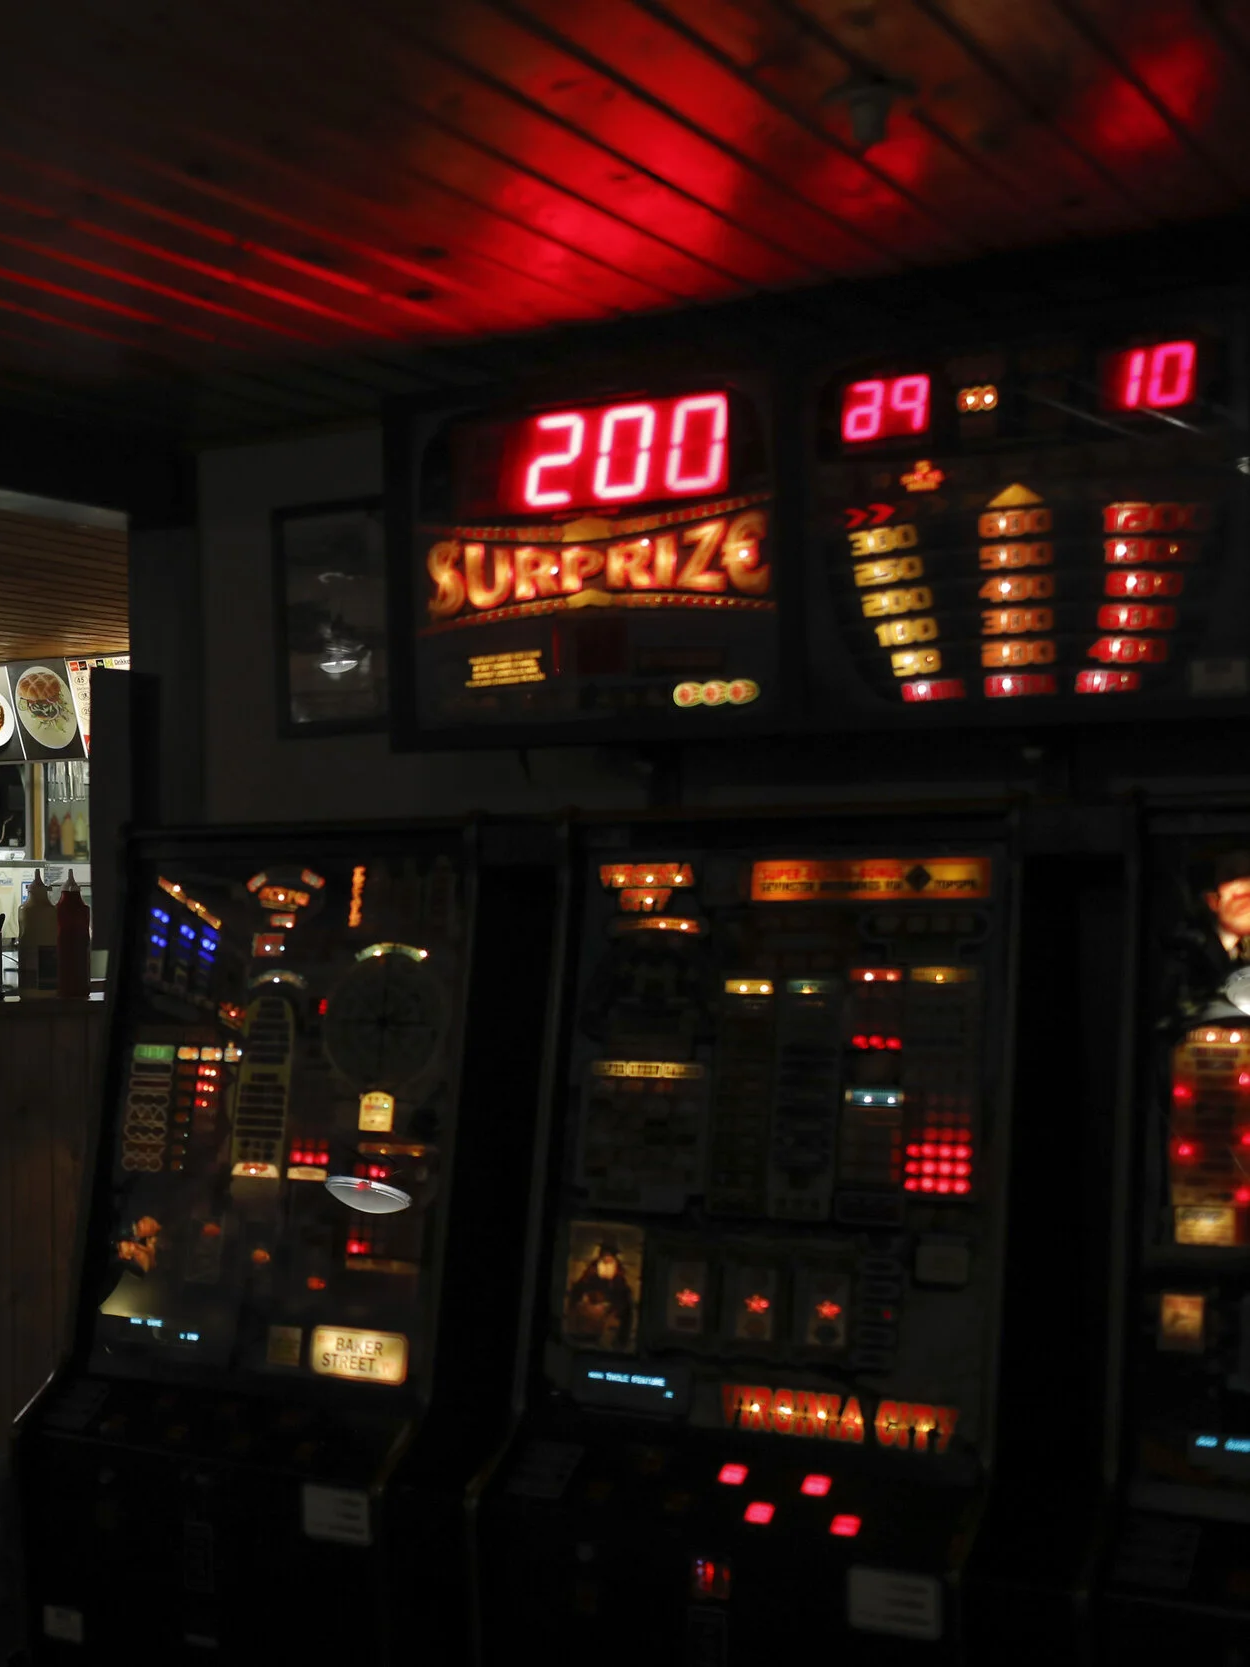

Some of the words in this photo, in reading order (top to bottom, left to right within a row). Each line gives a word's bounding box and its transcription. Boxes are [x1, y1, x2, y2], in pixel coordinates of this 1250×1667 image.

[1125, 340, 1196, 408] 10
[522, 390, 730, 510] 200
[847, 522, 919, 557] 300
[978, 540, 1054, 571] 500
[853, 554, 925, 588] 250
[860, 585, 934, 618] 200
[977, 573, 1055, 603] 400
[874, 616, 940, 648] 100
[980, 607, 1055, 636] 300
[890, 647, 943, 677] 50
[335, 1337, 383, 1356] BAKER
[722, 1384, 864, 1443] VIRGINIA
[875, 1399, 959, 1453] CITY
